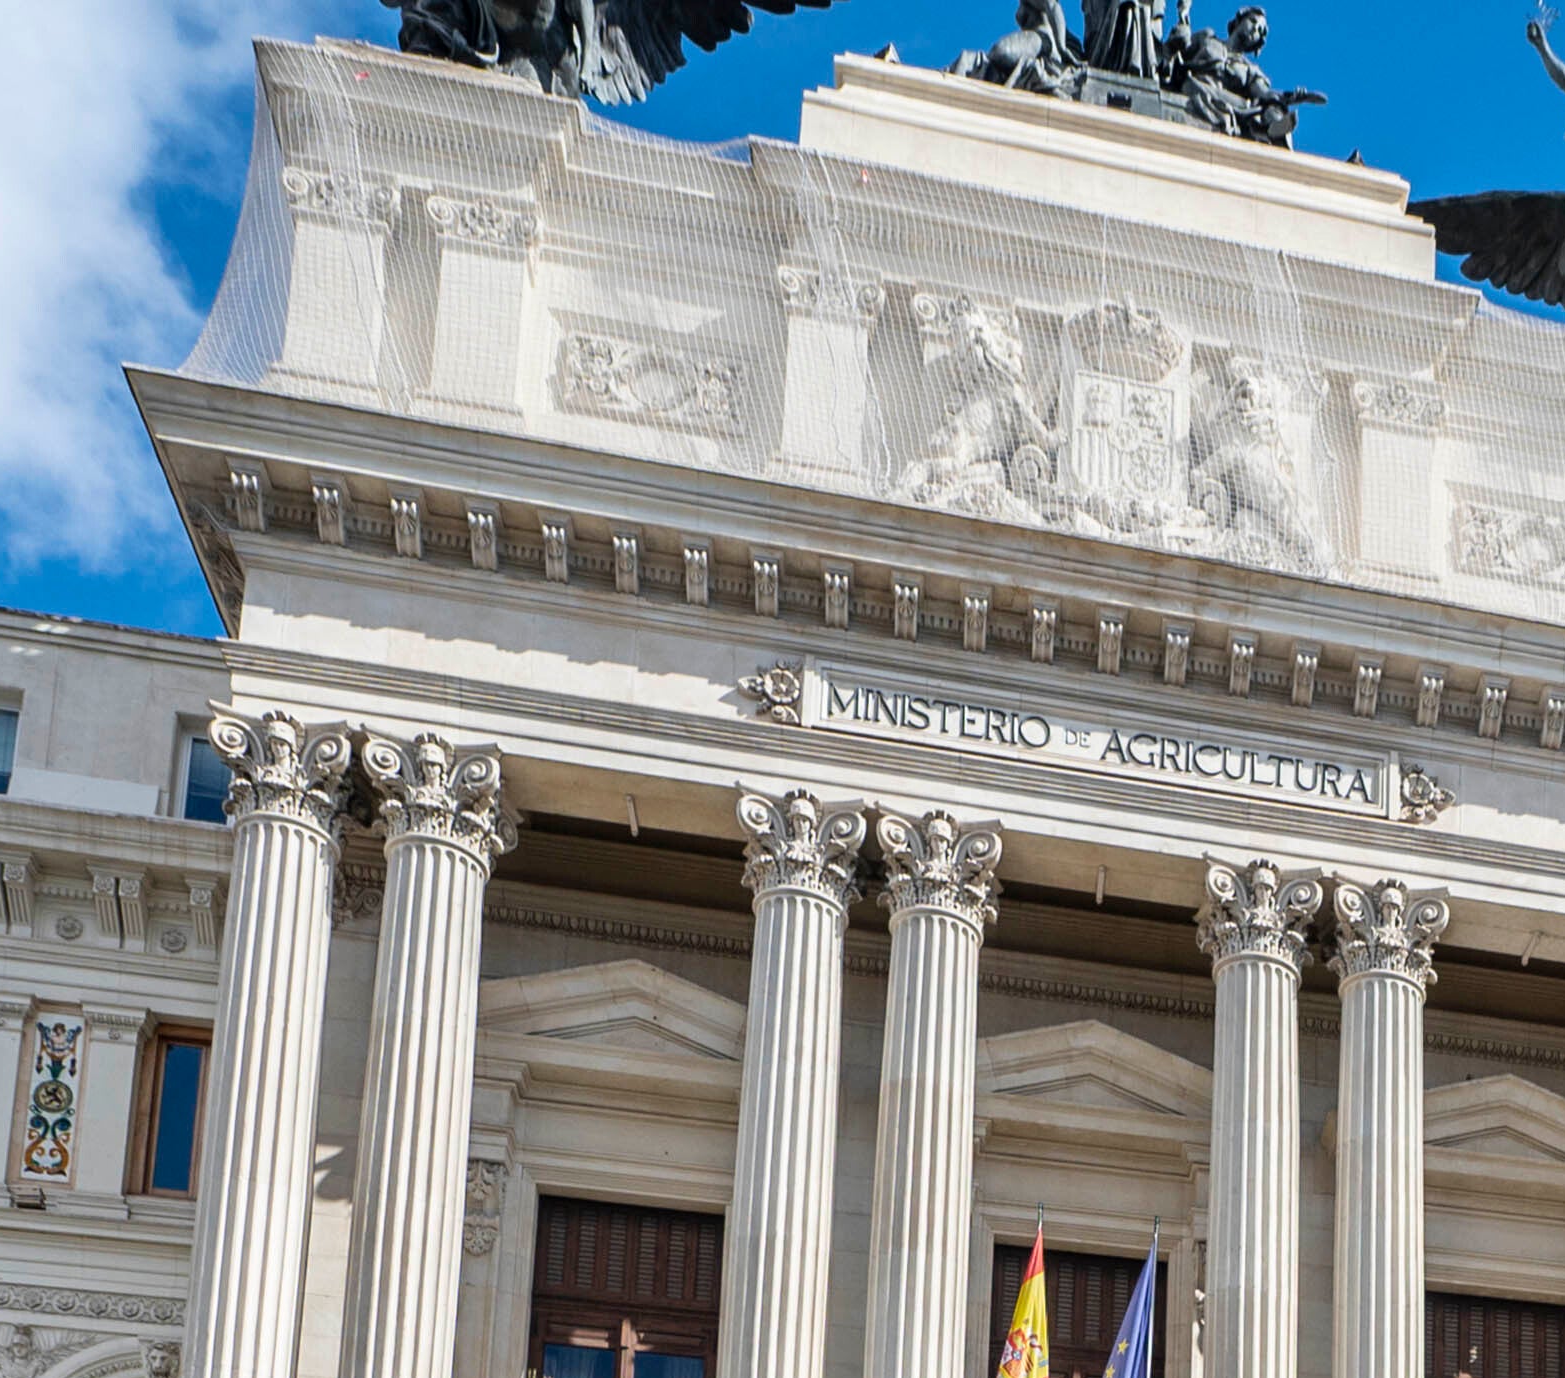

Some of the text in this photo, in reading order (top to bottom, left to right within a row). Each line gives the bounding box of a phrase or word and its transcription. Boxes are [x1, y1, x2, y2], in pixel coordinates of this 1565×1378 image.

[827, 679, 1374, 806] MINISTERIO DE AGRICULTURA
